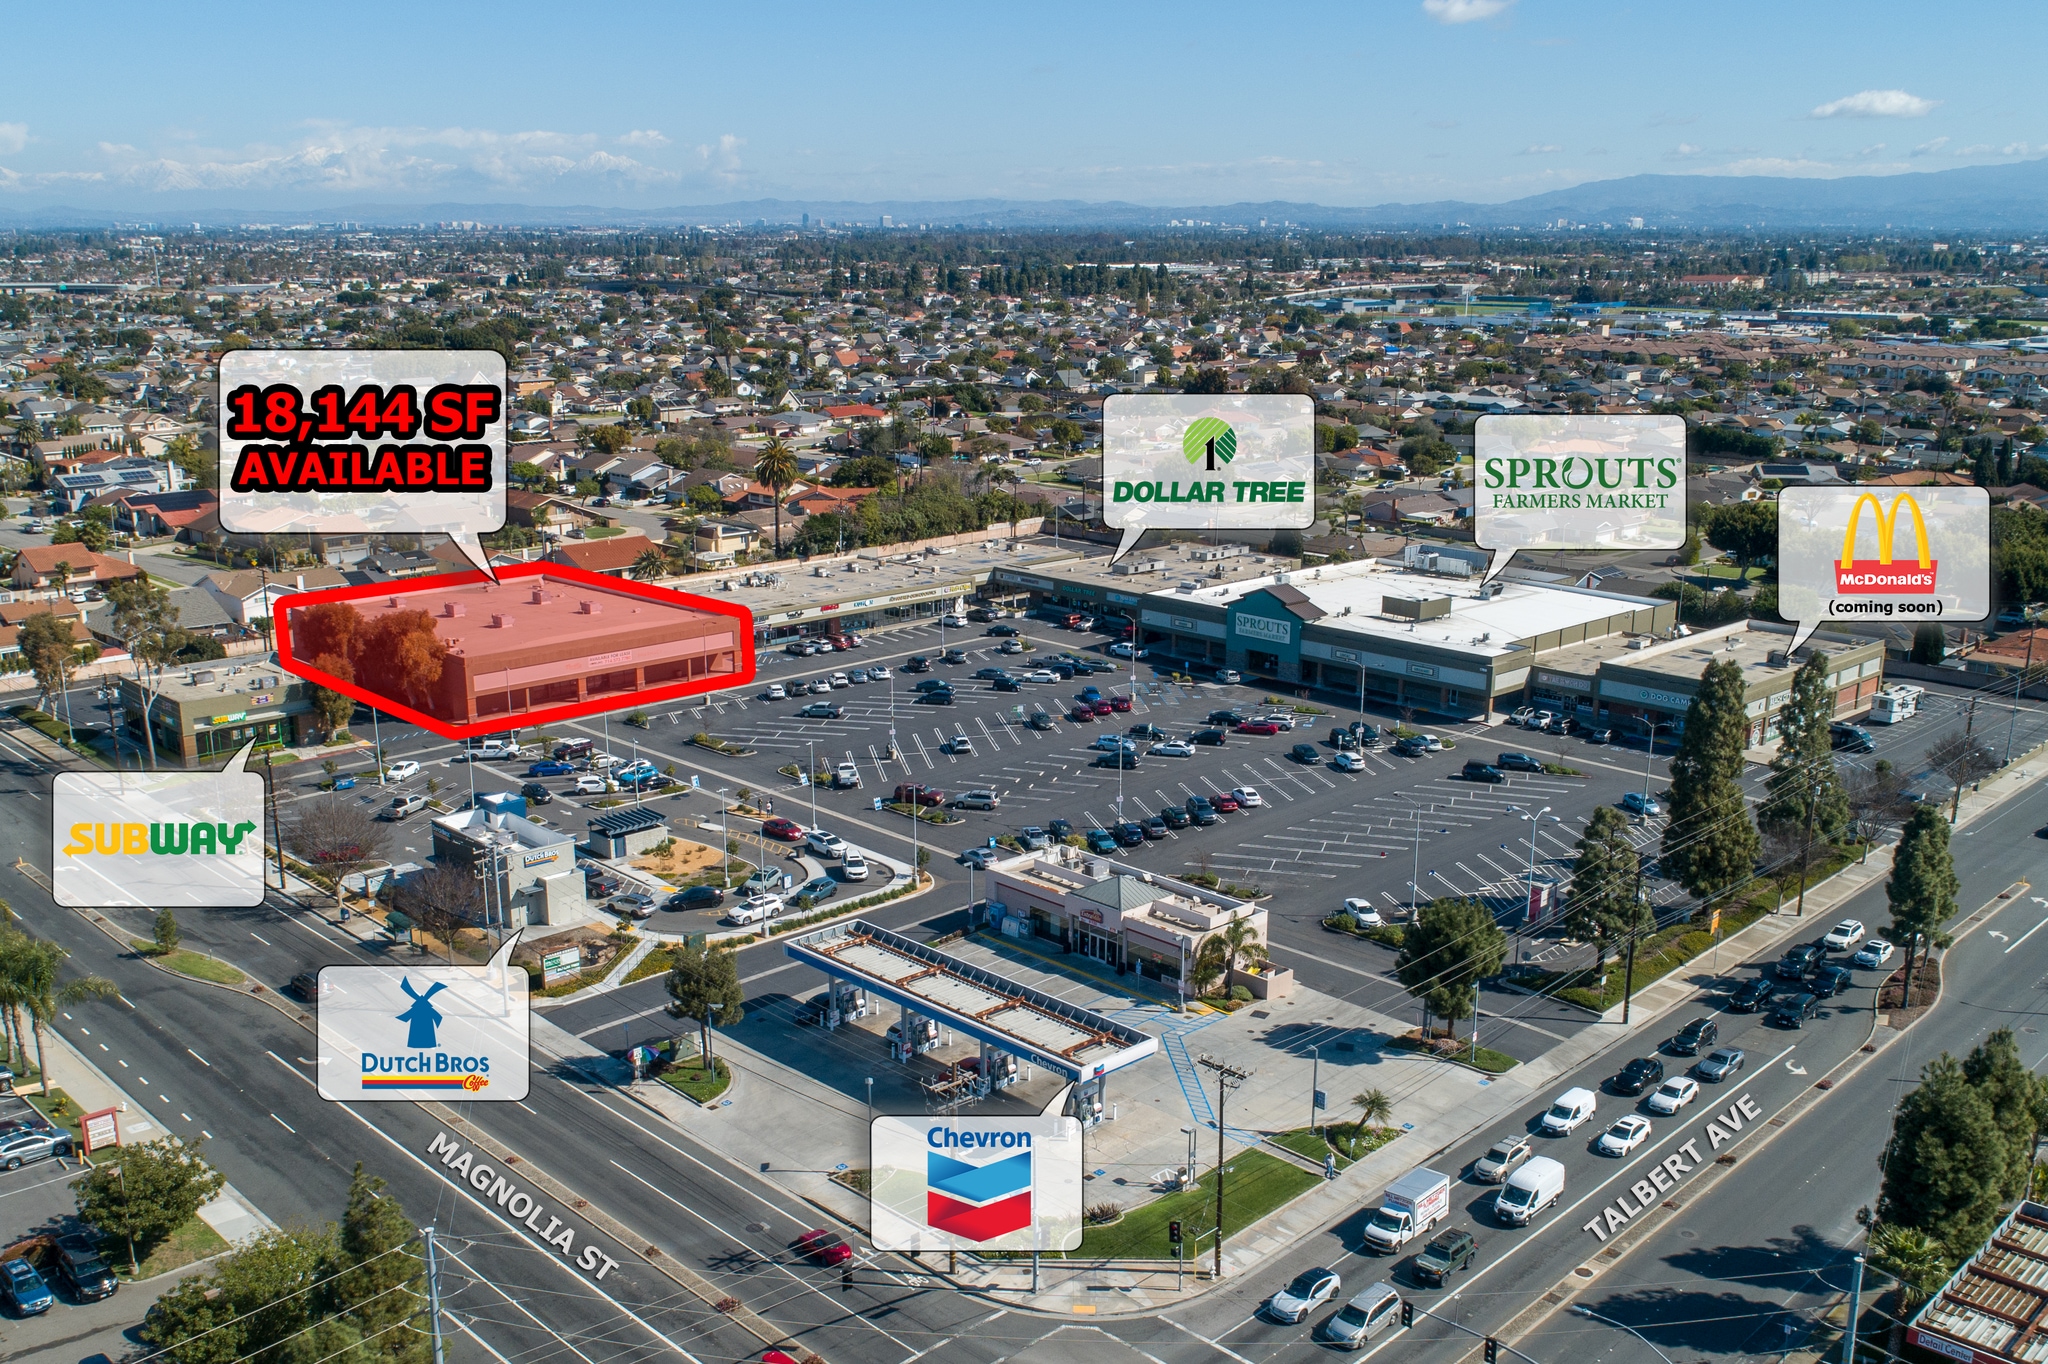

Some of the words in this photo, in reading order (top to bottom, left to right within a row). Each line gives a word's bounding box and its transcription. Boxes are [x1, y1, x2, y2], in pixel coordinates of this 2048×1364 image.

[1062, 585, 1082, 594] DOLLAR
[1083, 588, 1096, 597] TREE
[1236, 615, 1288, 635] SPROUTS
[1650, 693, 1669, 703] DOG
[212, 711, 247, 725] SUBWAY
[545, 849, 559, 859] BROS
[1031, 1054, 1068, 1077] Chevron
[1919, 1333, 1944, 1351] Detail
[1944, 1343, 1972, 1361] Center
